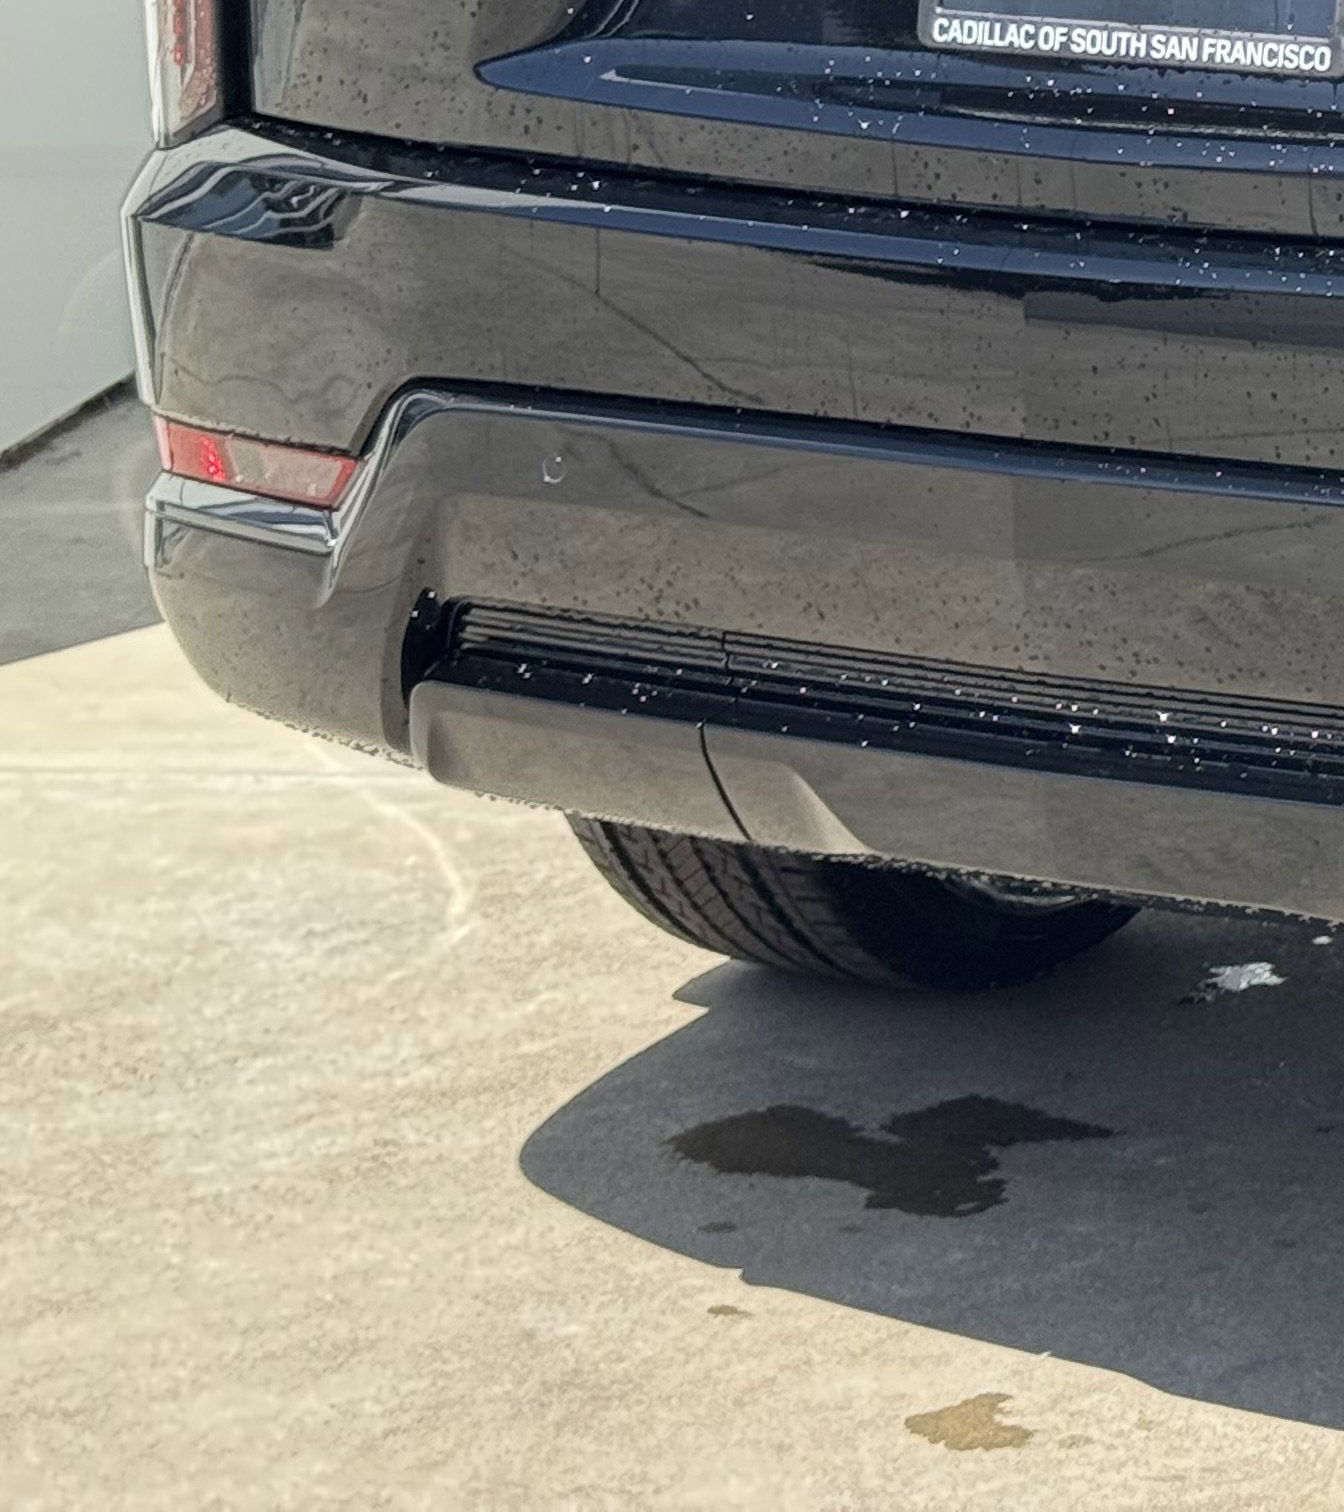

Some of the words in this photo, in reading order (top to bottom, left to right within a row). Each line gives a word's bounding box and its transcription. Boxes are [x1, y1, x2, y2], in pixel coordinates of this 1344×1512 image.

[932, 17, 1036, 50] CADILLAC
[1037, 24, 1069, 52] OF
[1068, 27, 1148, 59] SOUTH
[1150, 33, 1199, 62] SAN
[1201, 37, 1333, 73] FRANCISCO
